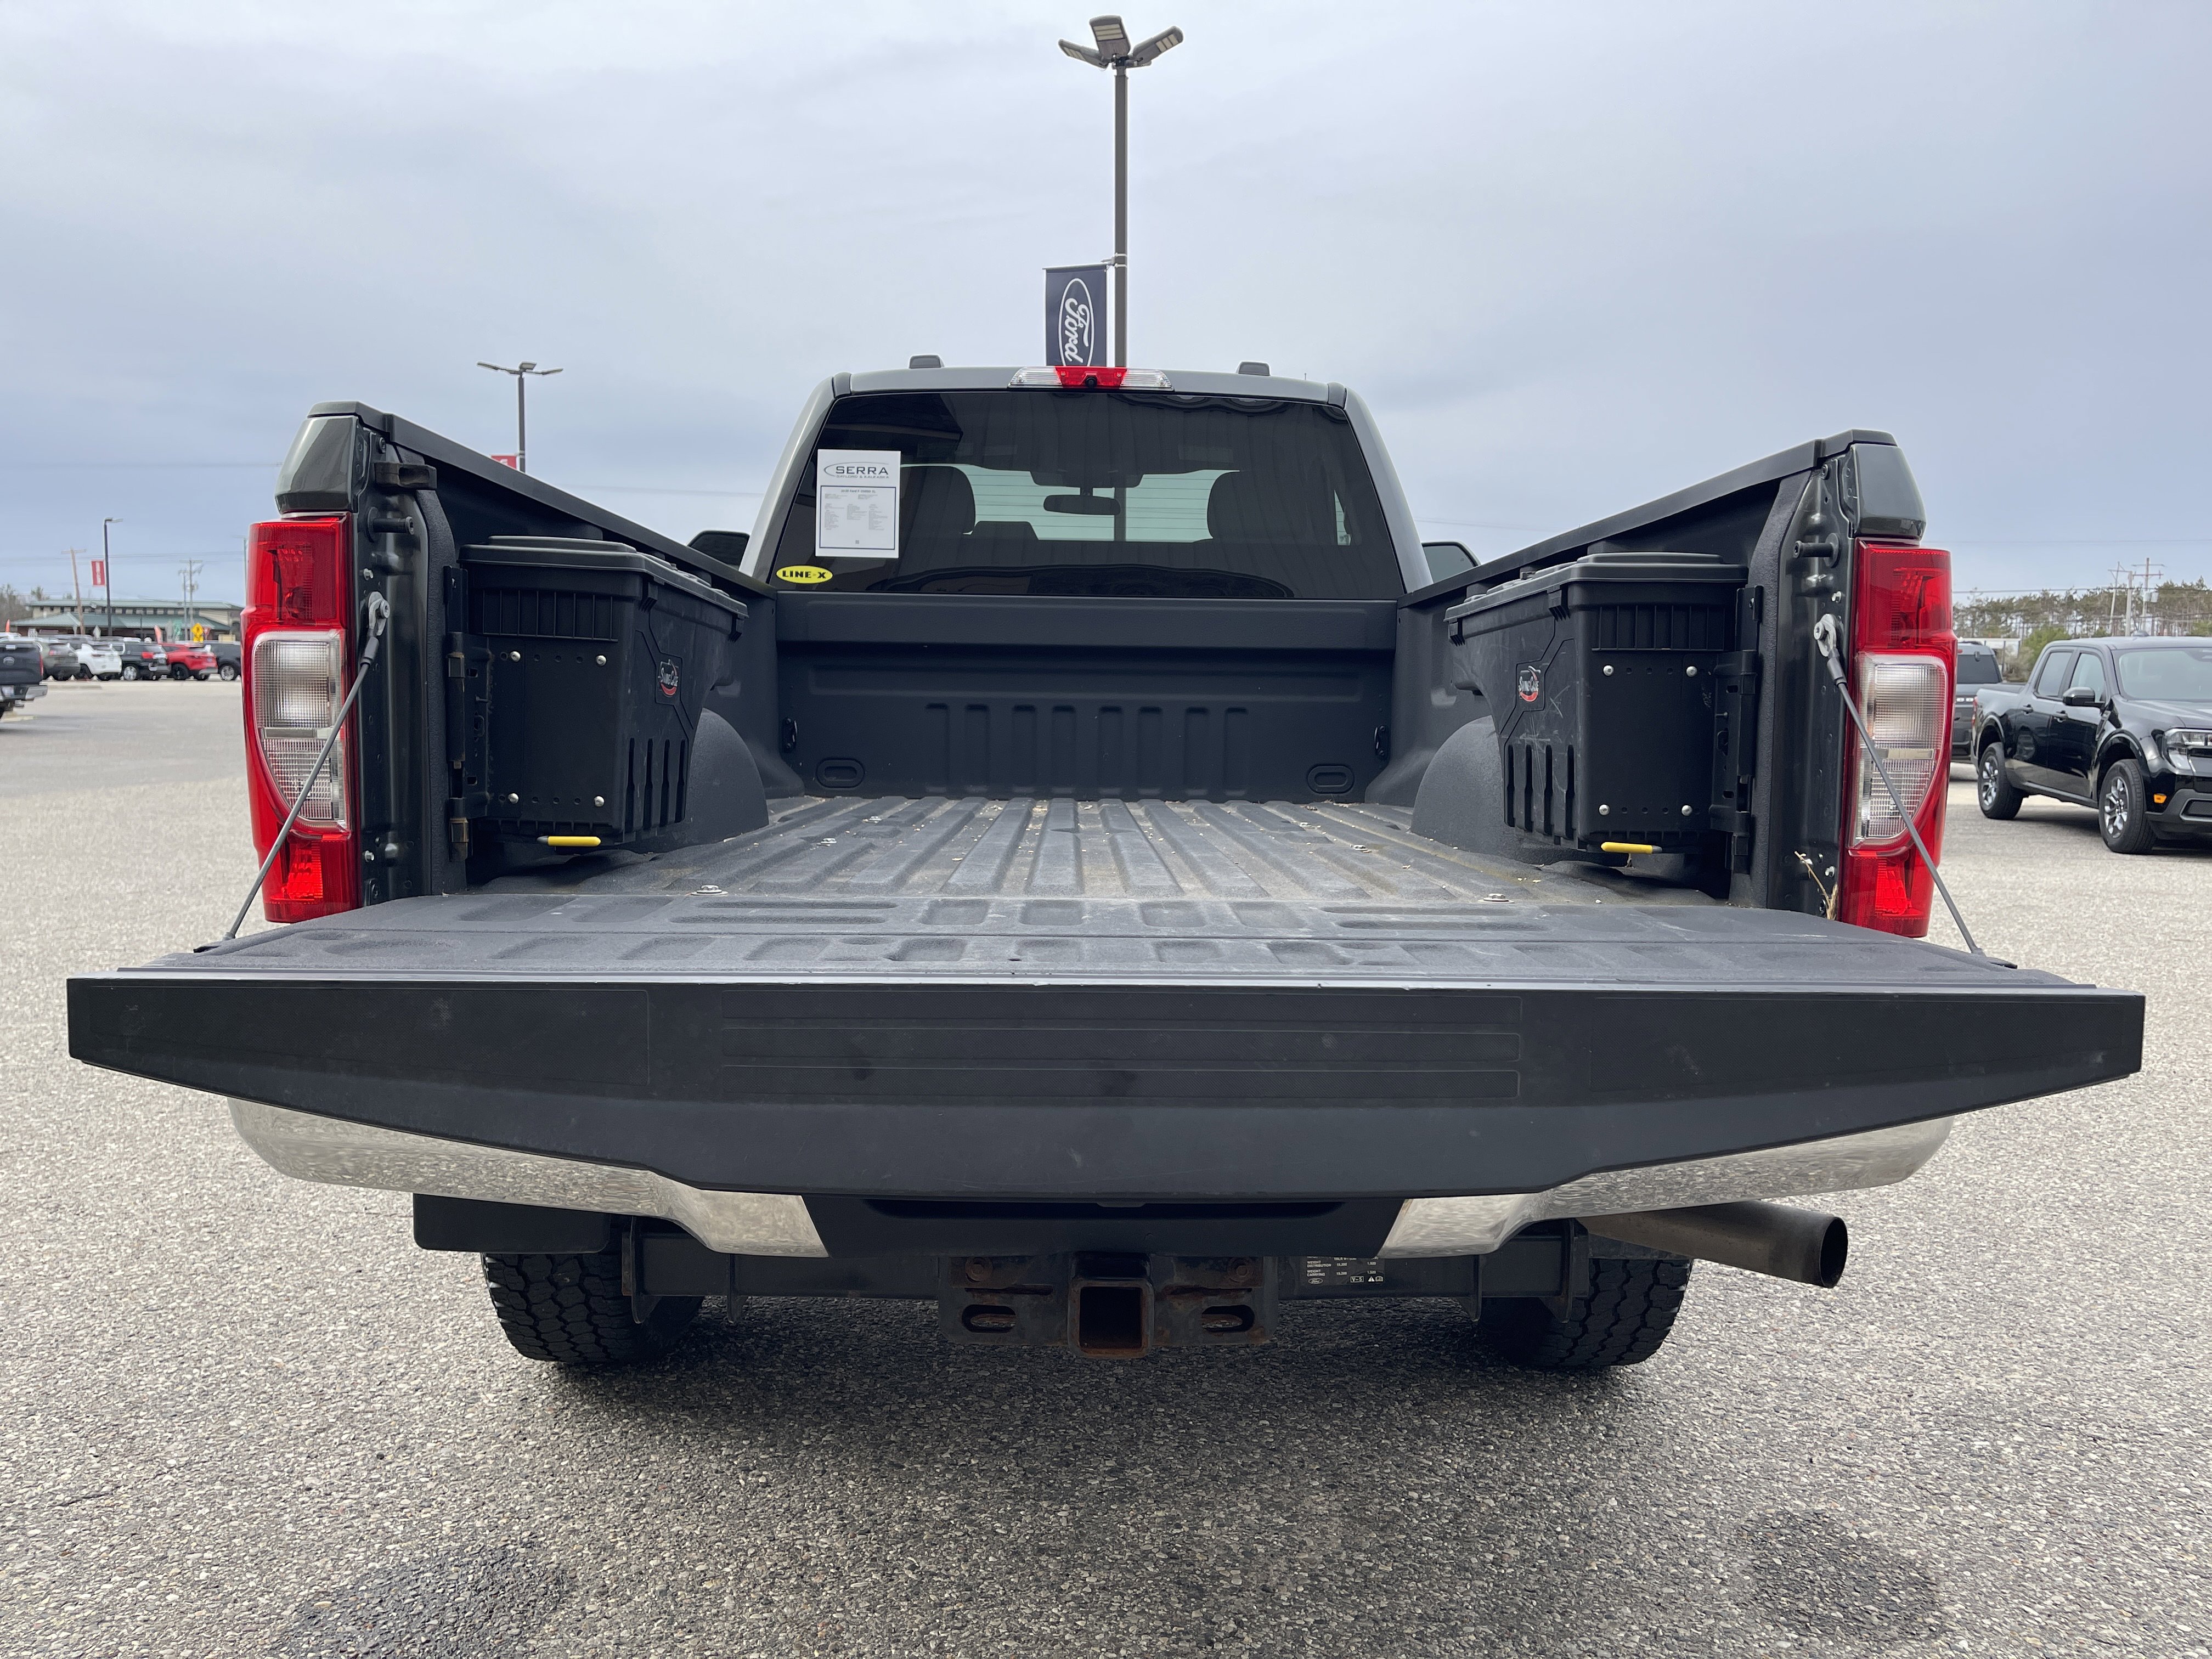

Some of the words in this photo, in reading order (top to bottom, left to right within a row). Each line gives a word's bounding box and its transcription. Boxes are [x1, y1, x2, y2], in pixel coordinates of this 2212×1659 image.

[1064, 298, 1090, 363] Ford
[836, 466, 888, 475] SERRA
[782, 570, 826, 579] LINE-X
